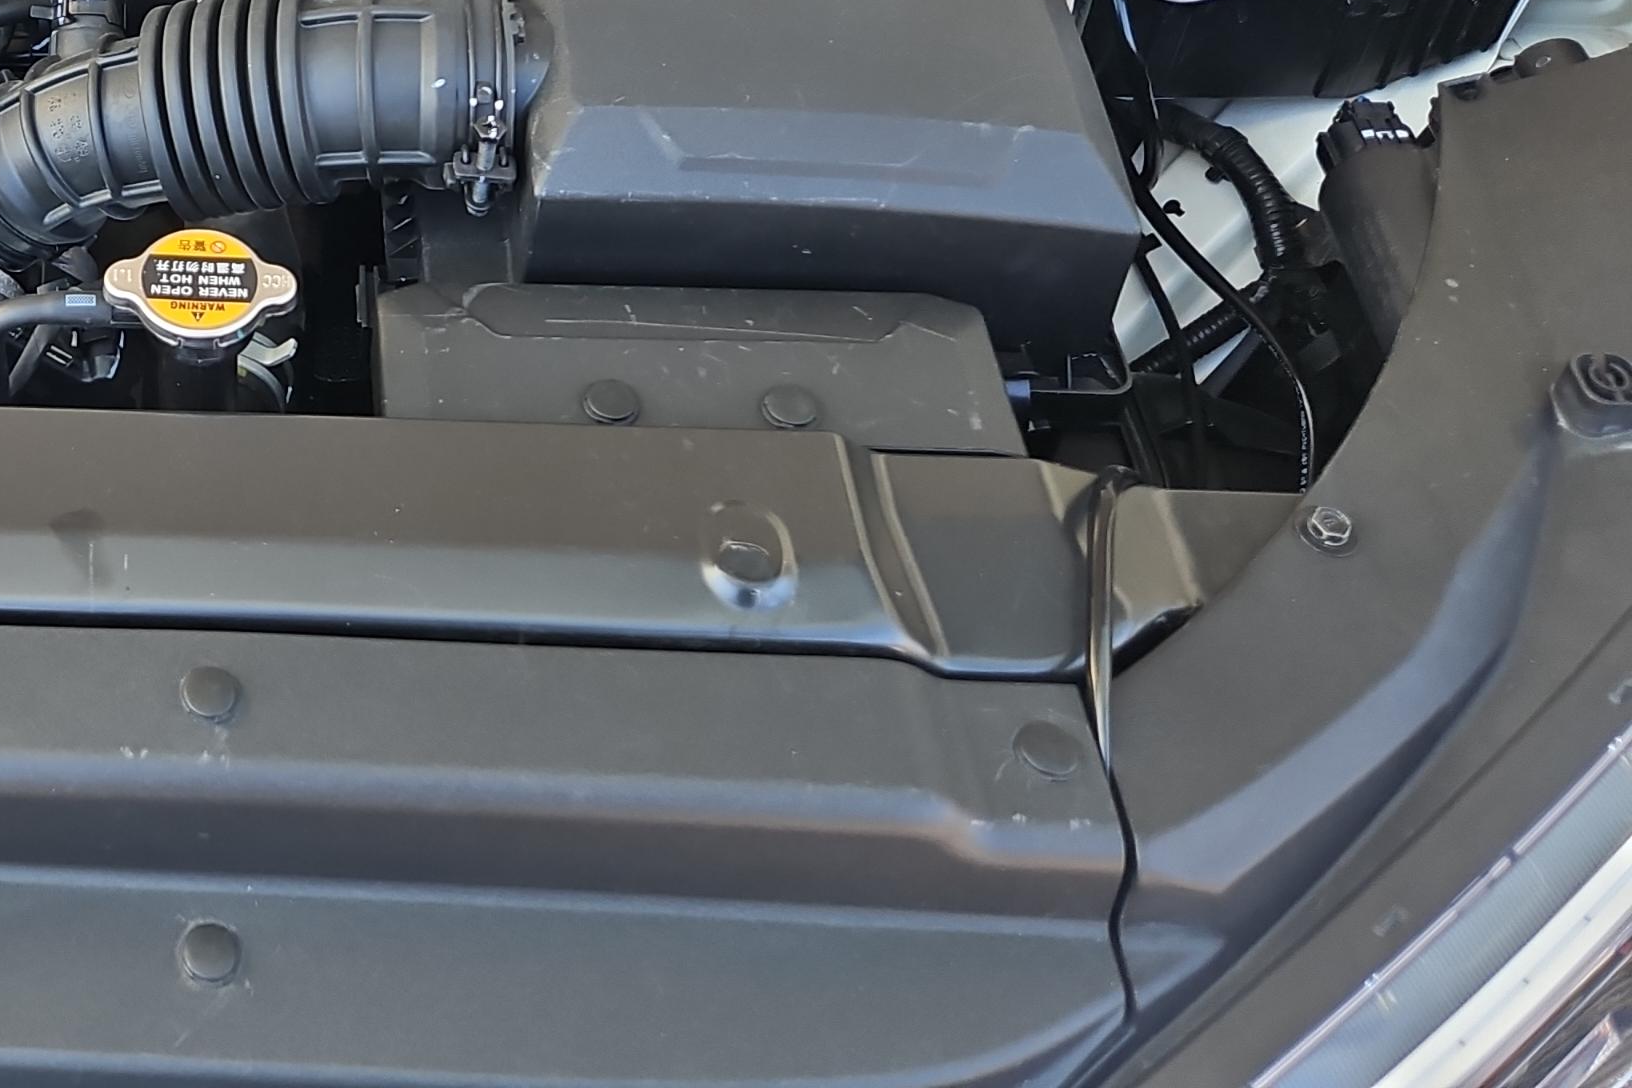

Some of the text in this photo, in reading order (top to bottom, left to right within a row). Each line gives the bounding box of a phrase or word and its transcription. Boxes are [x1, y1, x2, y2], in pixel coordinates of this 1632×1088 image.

[198, 275, 241, 286] WHEN
[150, 285, 249, 298] NEVER OPEN
[170, 300, 225, 311] WARNING
